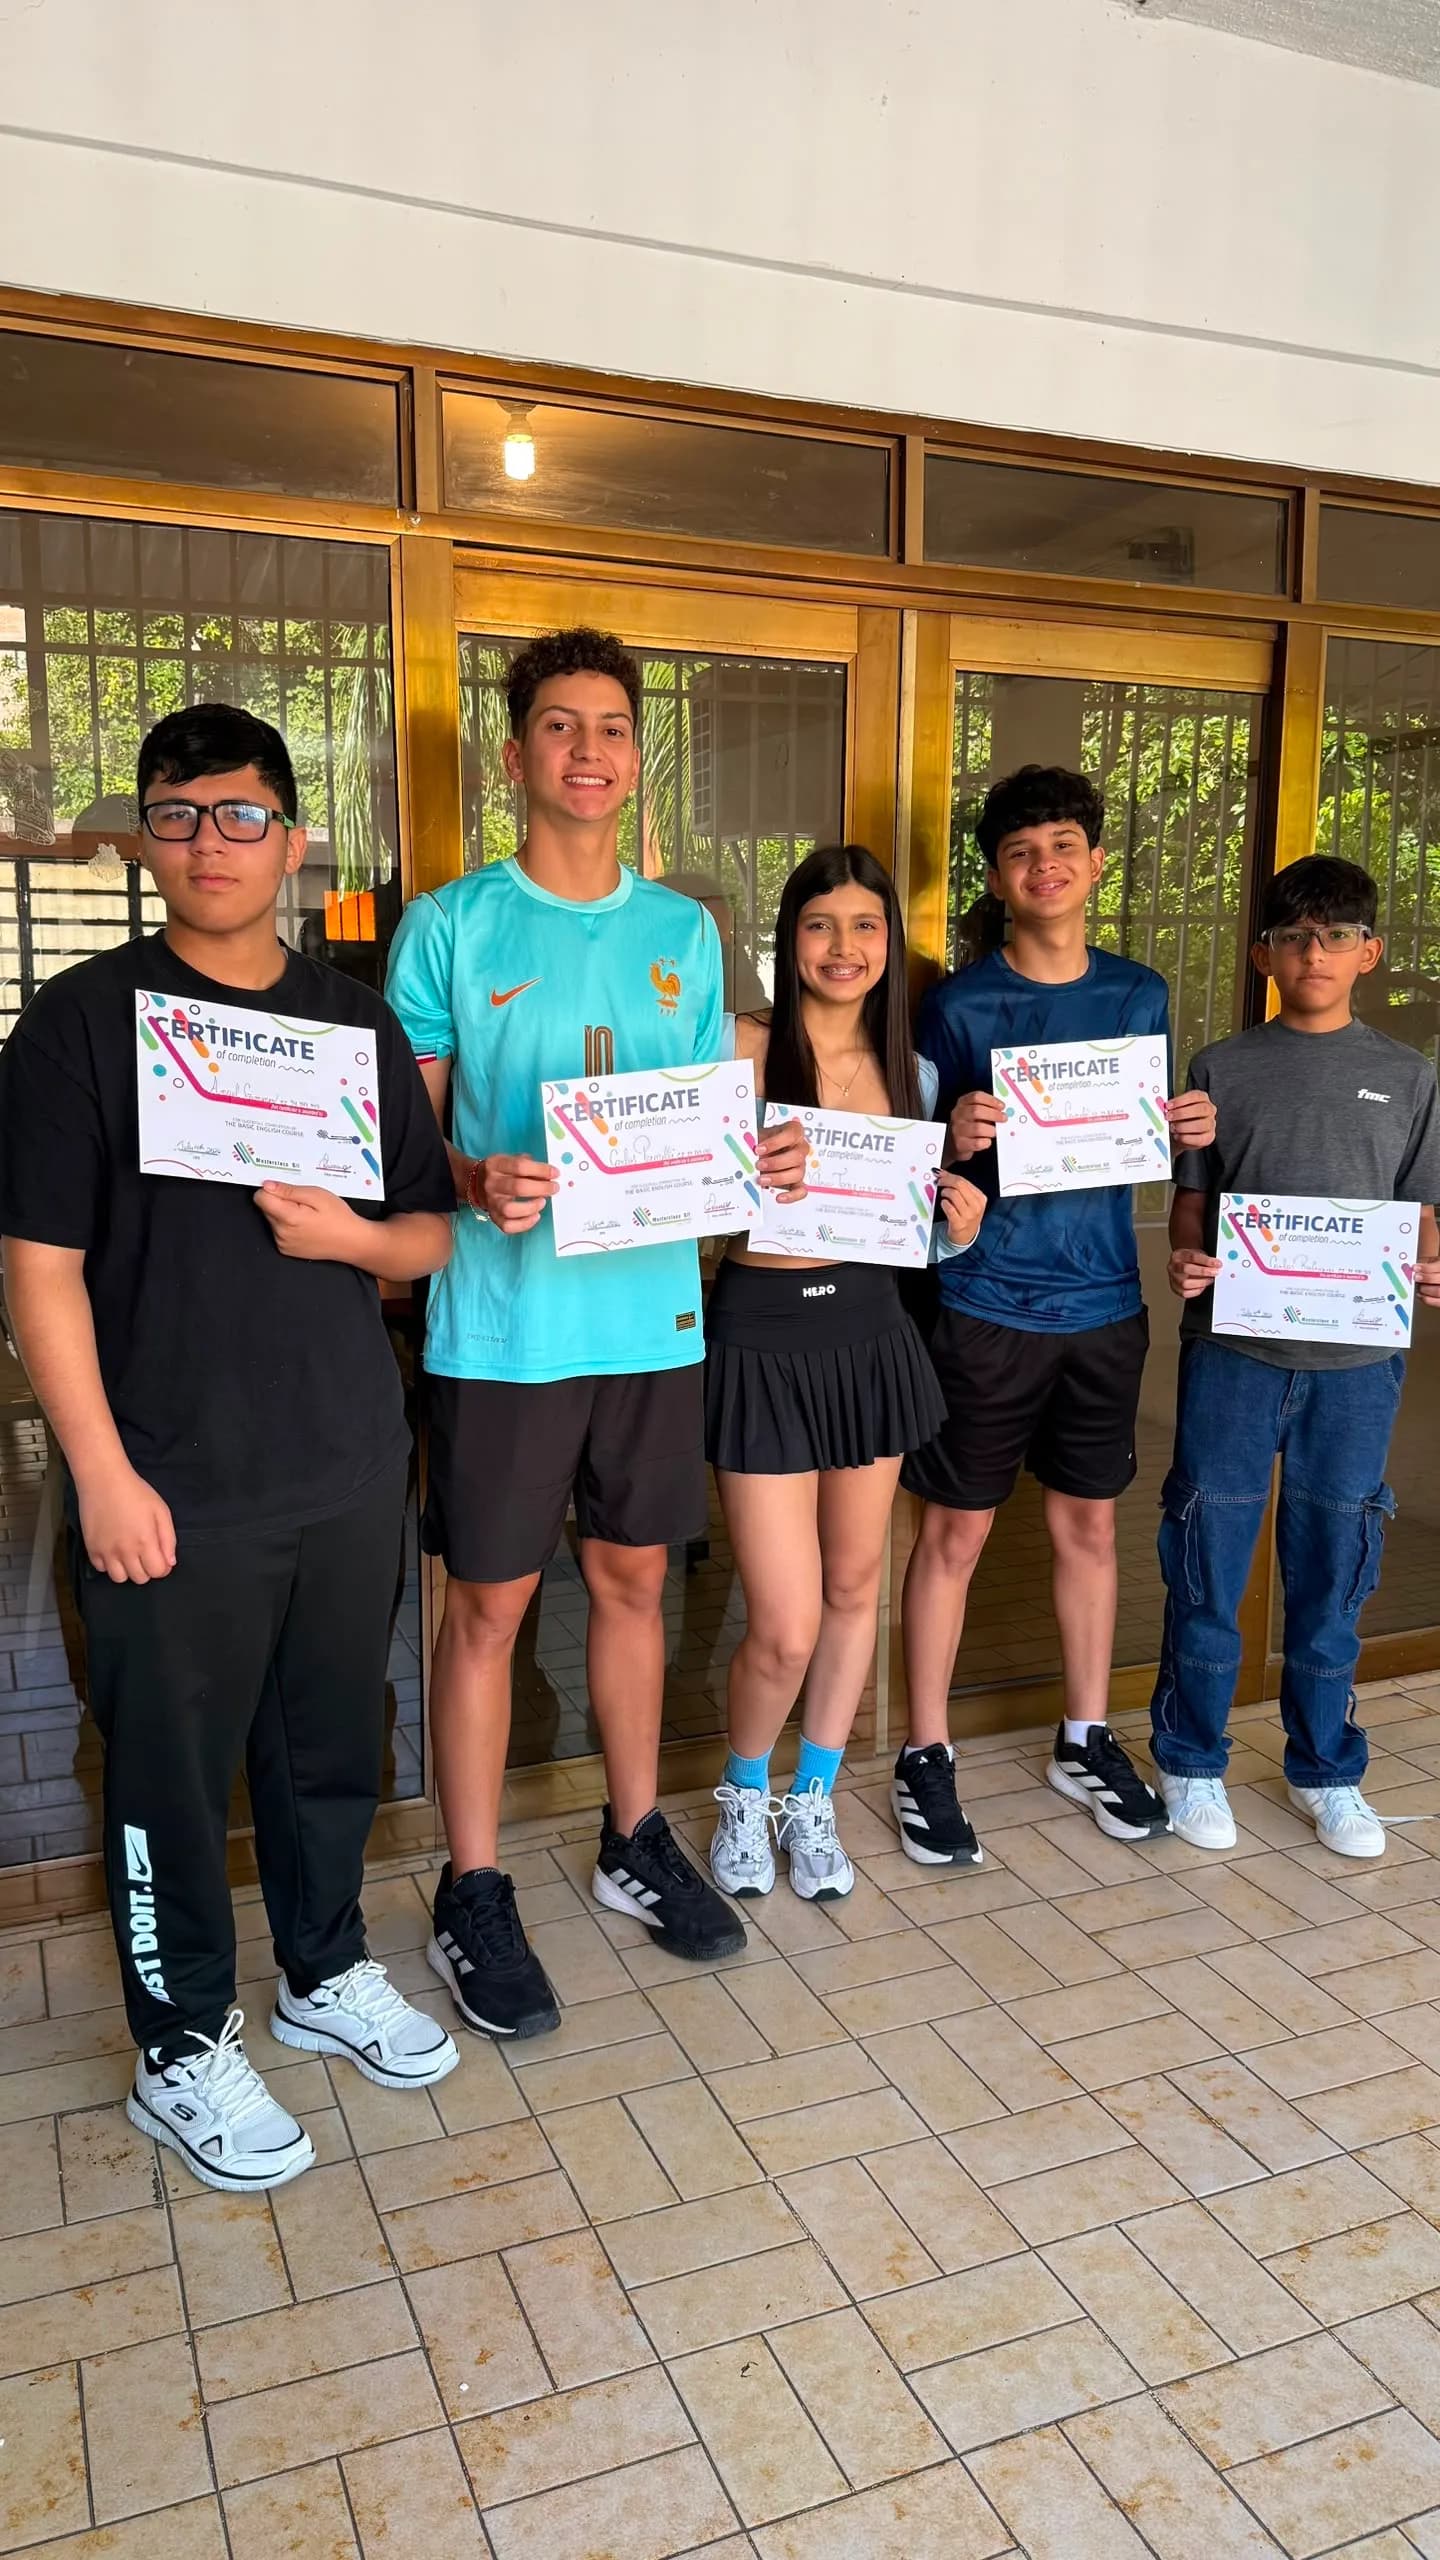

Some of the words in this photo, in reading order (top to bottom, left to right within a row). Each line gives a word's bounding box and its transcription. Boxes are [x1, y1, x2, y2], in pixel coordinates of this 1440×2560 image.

[155, 1016, 315, 1061] CERTIFICATE
[583, 1024, 614, 1077] 10
[216, 1049, 227, 1060] of
[228, 1051, 277, 1069] completion
[1006, 1057, 1120, 1082] CERTIFICATE
[560, 1088, 700, 1122] CERTIFICATE
[614, 1119, 624, 1131] of
[624, 1115, 667, 1130] completion
[803, 1126, 896, 1153] RTIFICATE
[1233, 1211, 1364, 1234] CERTIFICATE
[1279, 1232, 1287, 1242] of
[1288, 1233, 1329, 1245] completion
[802, 1284, 836, 1298] HERO
[134, 1958, 177, 2007] UST
